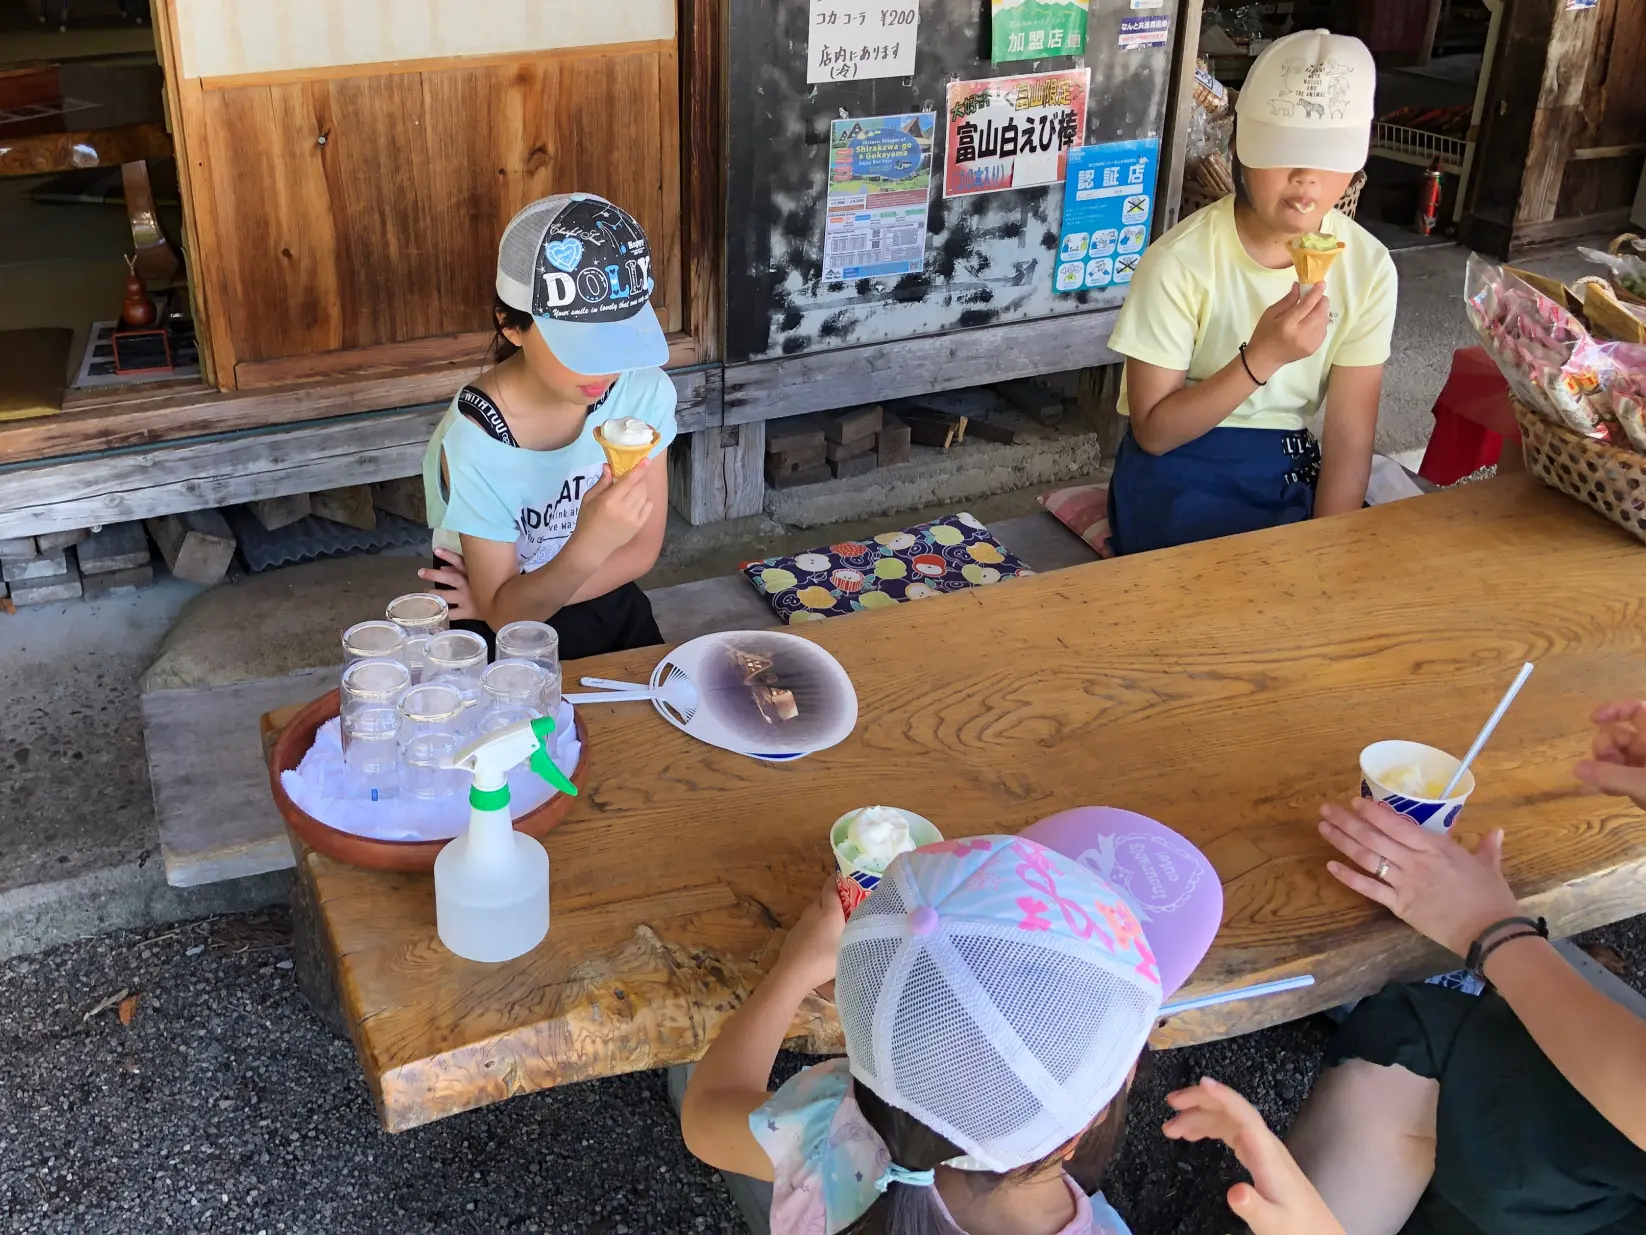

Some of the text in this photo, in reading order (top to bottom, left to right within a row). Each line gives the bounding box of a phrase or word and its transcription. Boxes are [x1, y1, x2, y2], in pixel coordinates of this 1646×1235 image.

[880, 9, 916, 27] ¥200
[1007, 29, 1064, 53] 加盟店
[819, 42, 900, 67] 店内にあります
[855, 143, 912, 153] Shirakawa-go
[955, 109, 1078, 165] 富山白えび棒
[865, 150, 908, 160] Gokayama
[1077, 163, 1145, 190] 認証店
[543, 257, 650, 305] DOLLY
